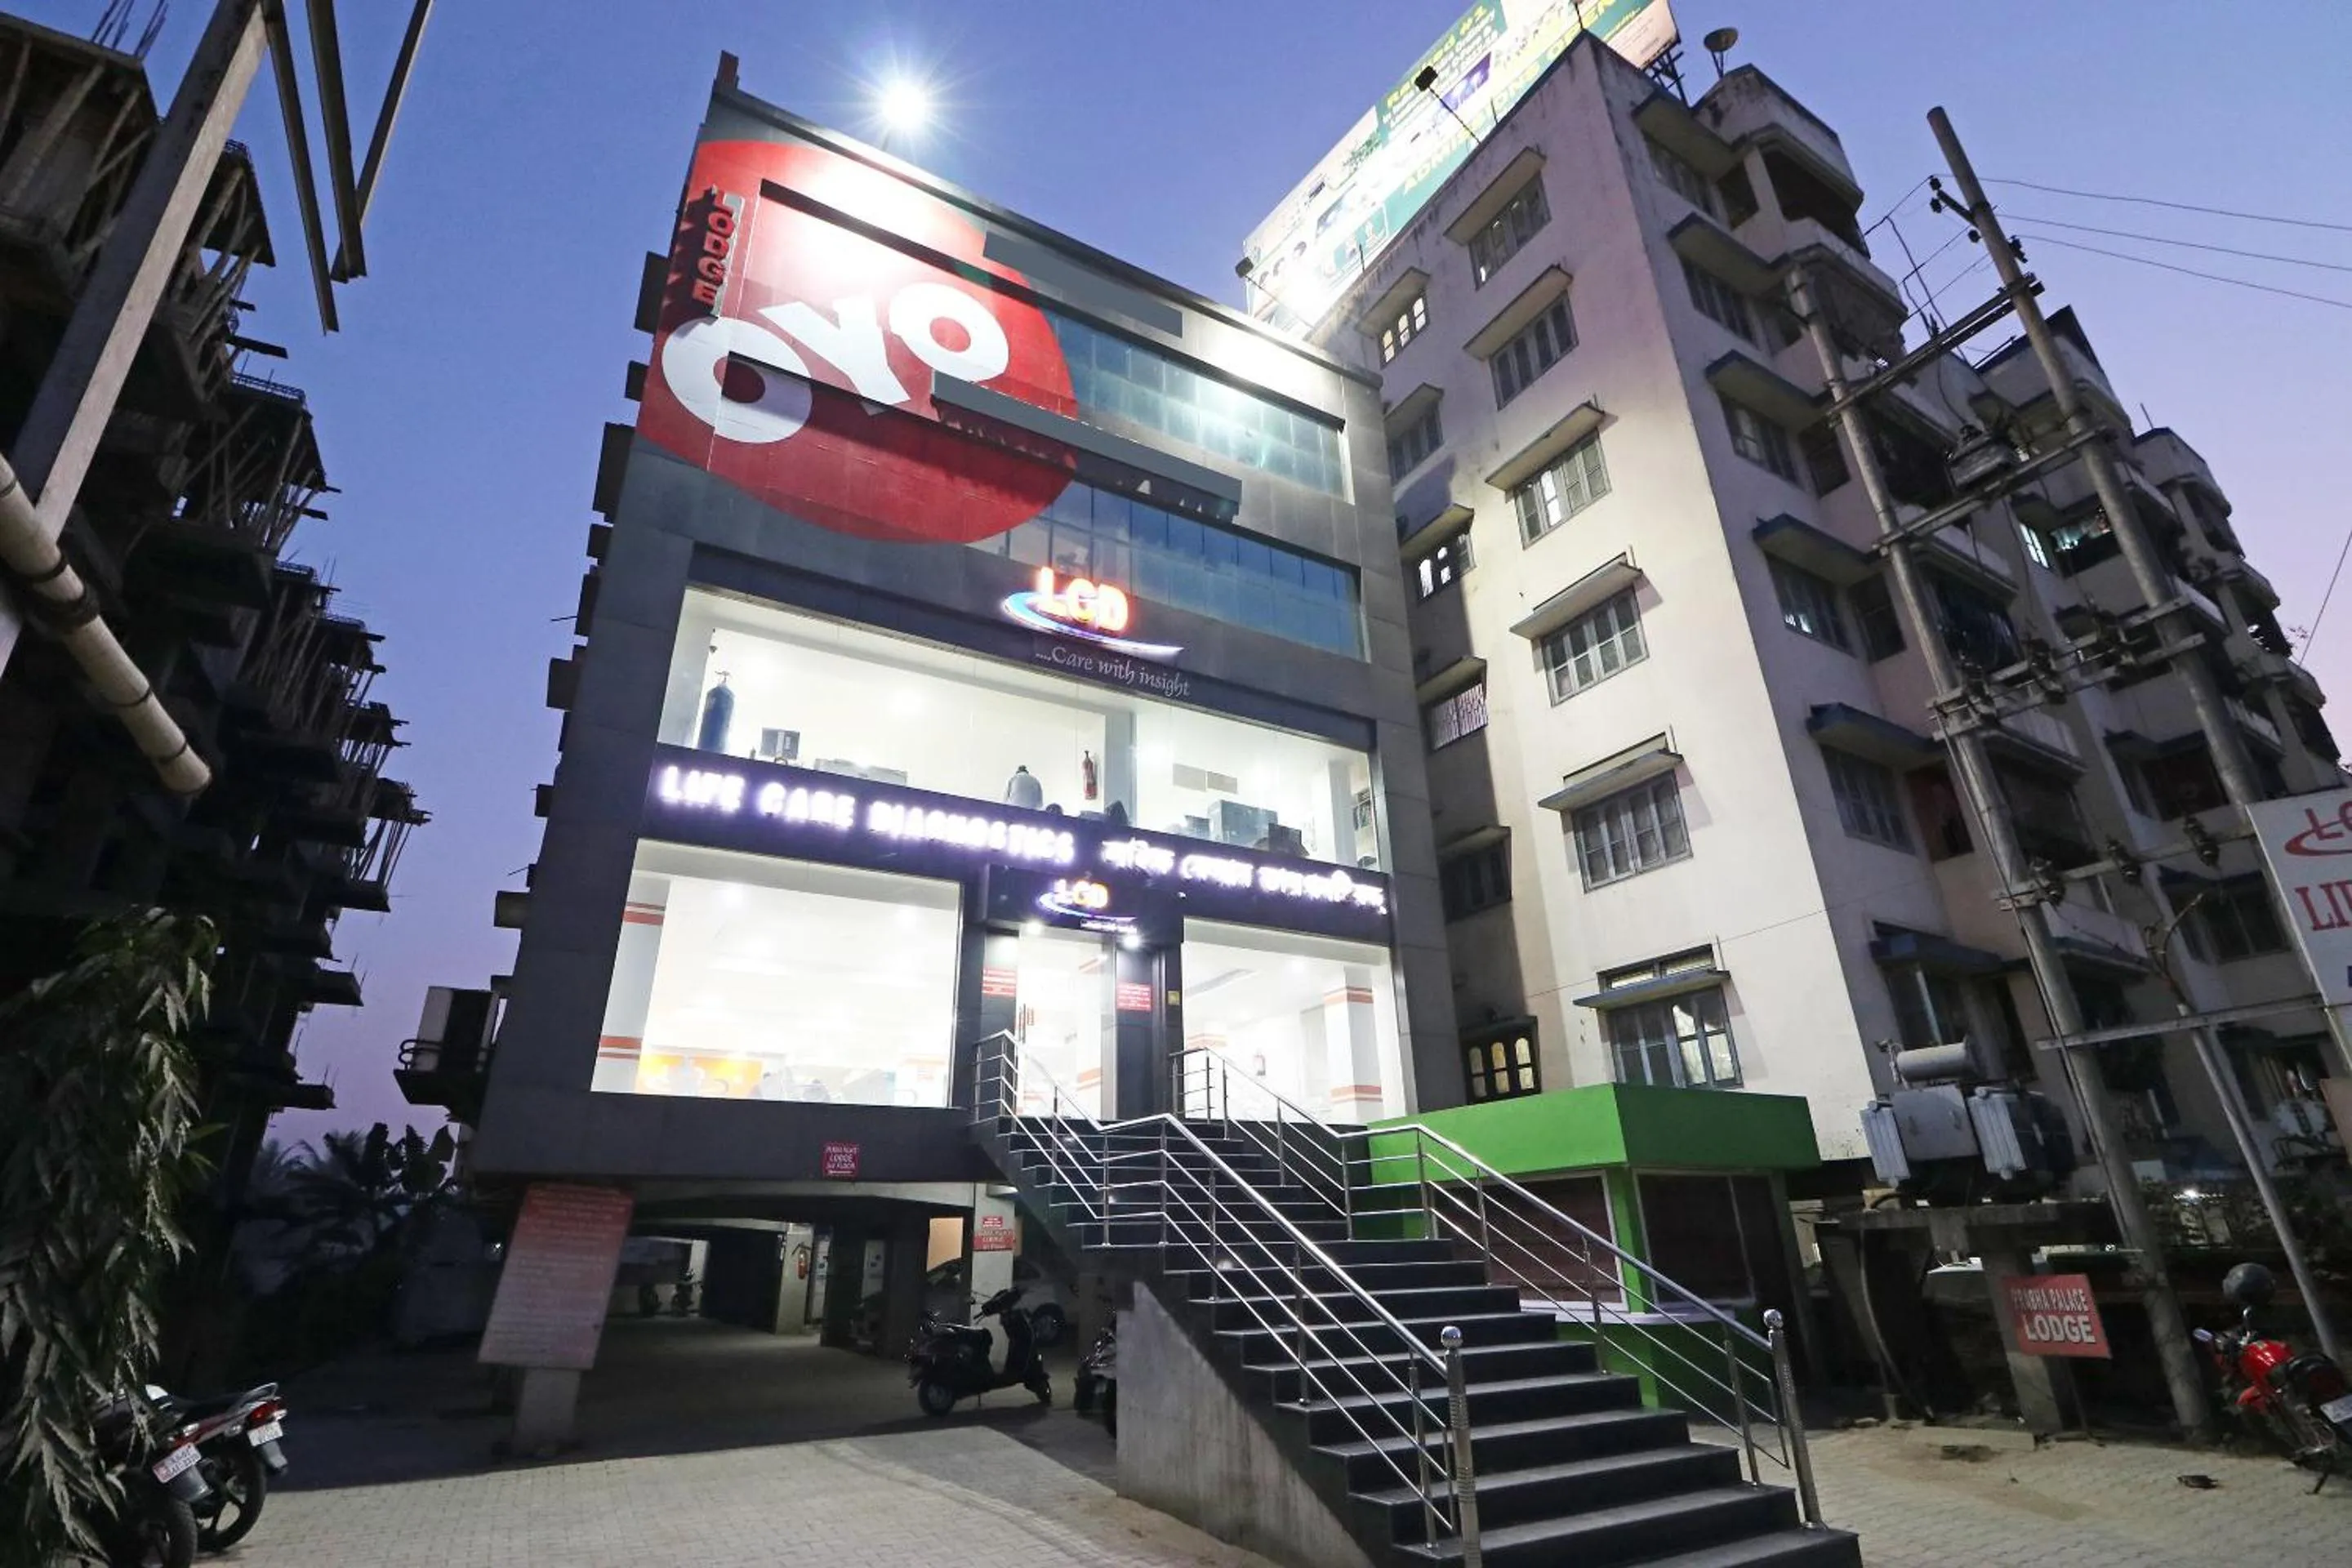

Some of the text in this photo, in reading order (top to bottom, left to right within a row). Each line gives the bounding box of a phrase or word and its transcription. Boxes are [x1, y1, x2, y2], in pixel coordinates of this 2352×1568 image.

[693, 185, 735, 308] LODGE
[662, 281, 1009, 443] OYO
[1098, 657, 1136, 684] with
[1139, 666, 1191, 697] insight
[659, 764, 746, 813] LIFE
[757, 782, 856, 831] CARE
[2022, 1314, 2097, 1343] LODGE
